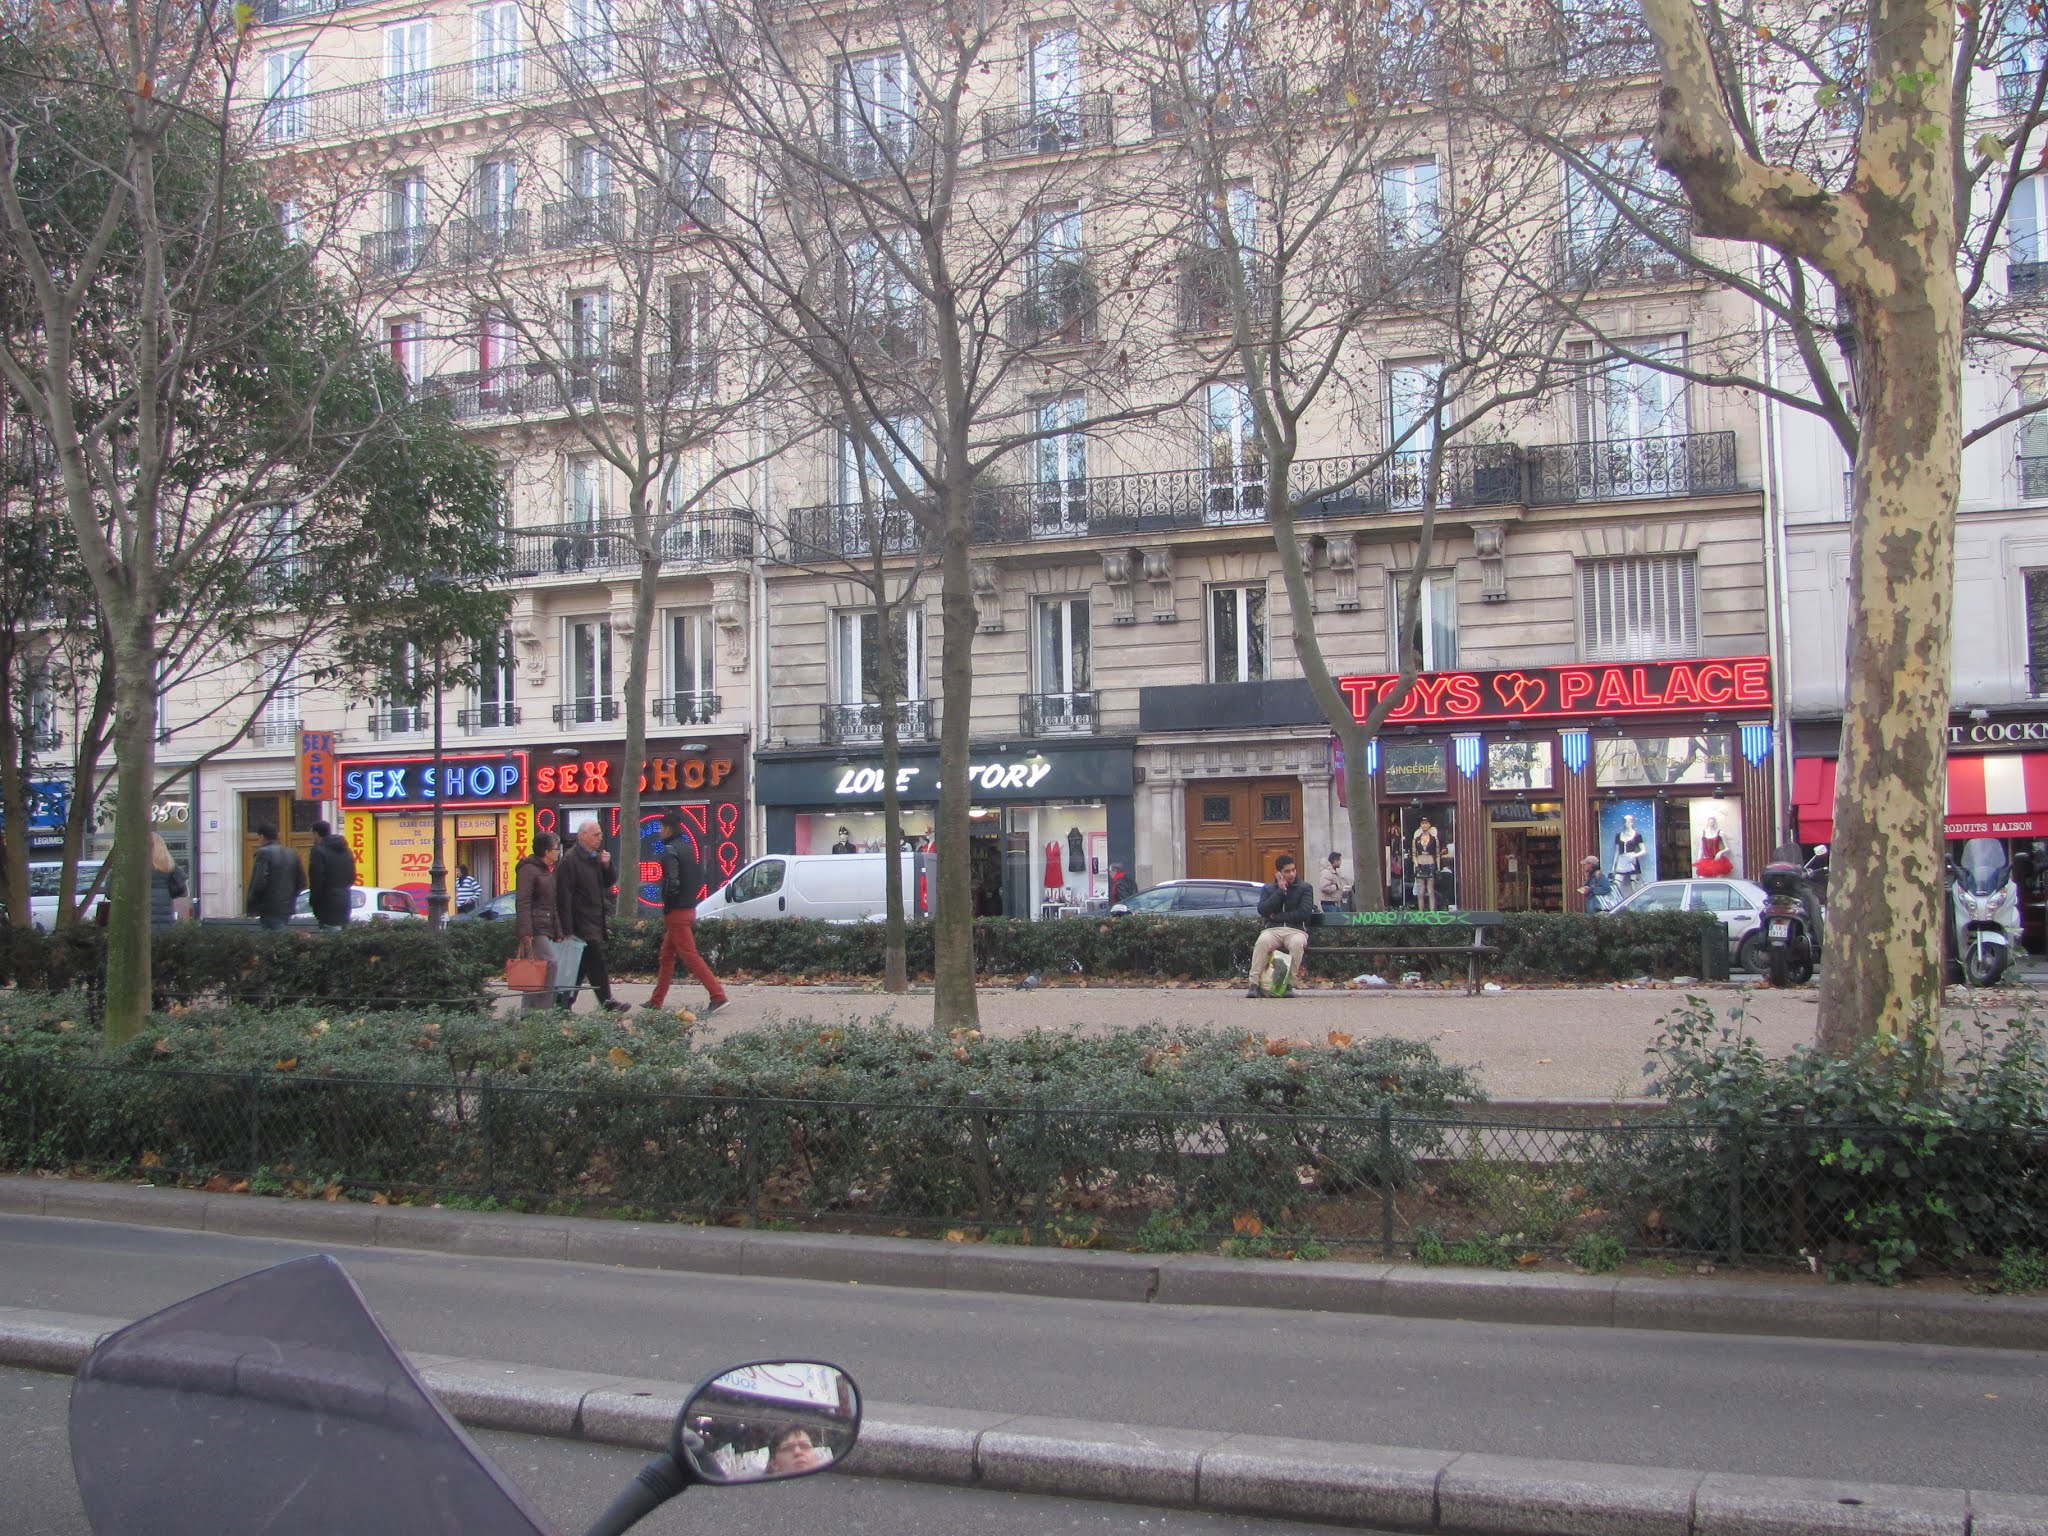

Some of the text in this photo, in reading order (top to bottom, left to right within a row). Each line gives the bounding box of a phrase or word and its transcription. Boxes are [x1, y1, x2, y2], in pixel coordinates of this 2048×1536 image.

[1340, 662, 1768, 717] TOYS PALACE
[302, 733, 332, 755] SEX
[310, 753, 323, 797] SHOP
[347, 765, 519, 800] SEX SHOP
[537, 760, 610, 794] SEX
[936, 763, 1051, 790] TORY
[458, 819, 496, 829] SEX SHOP
[515, 811, 528, 861] SEX
[1944, 821, 2033, 833] RODUITS MAISON
[34, 836, 64, 845] LEGUMES
[353, 816, 365, 864] SEX
[502, 825, 510, 853] SEX
[401, 853, 433, 866] DVD
